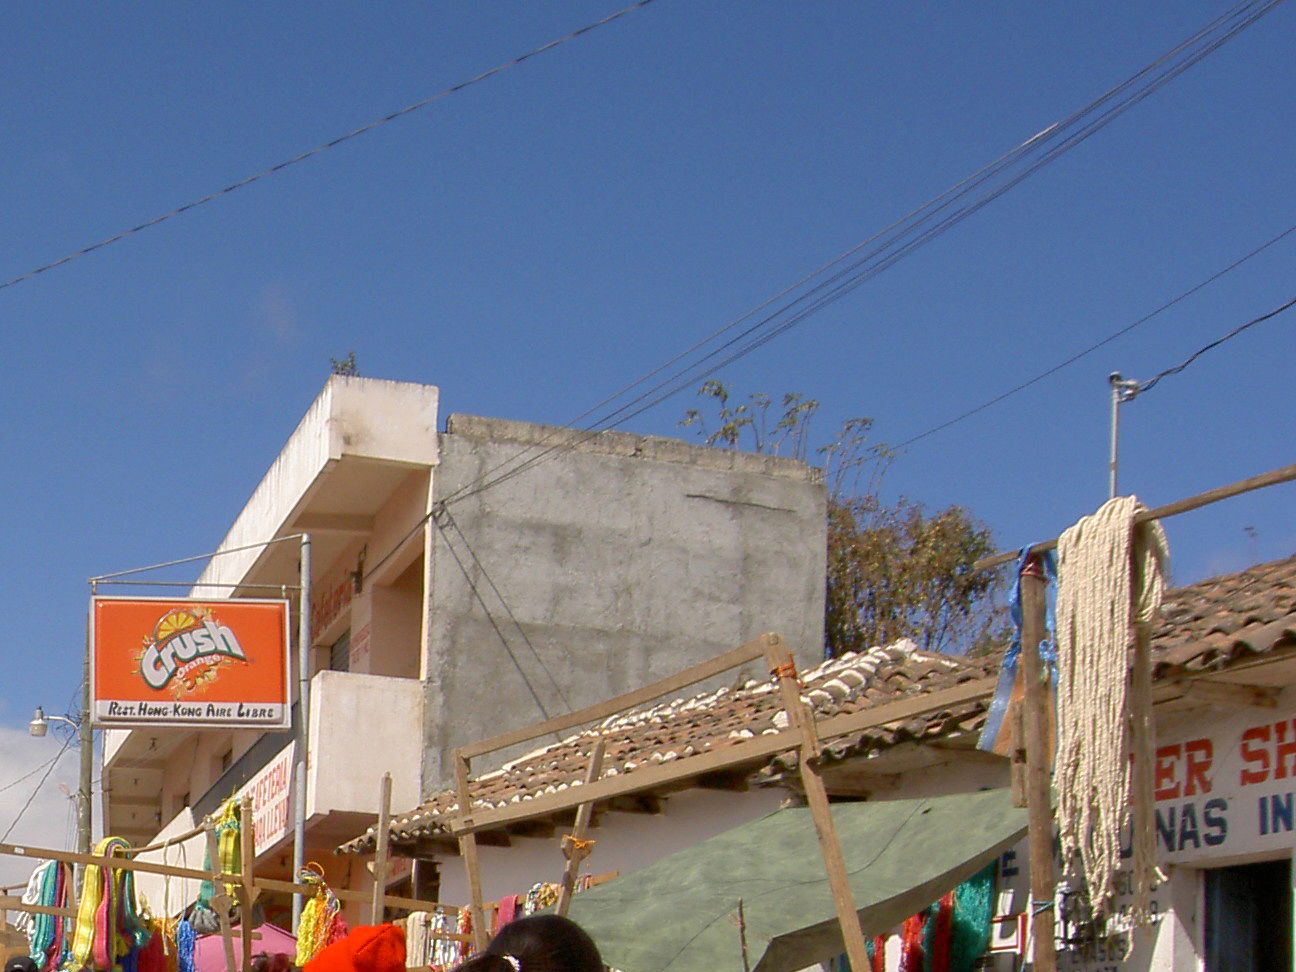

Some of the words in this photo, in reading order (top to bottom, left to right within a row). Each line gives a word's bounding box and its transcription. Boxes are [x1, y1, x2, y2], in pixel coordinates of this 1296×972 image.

[142, 620, 245, 688] Crush
[206, 702, 232, 717] AIRE
[237, 701, 274, 718] LIBRE
[1154, 737, 1214, 802] ER
